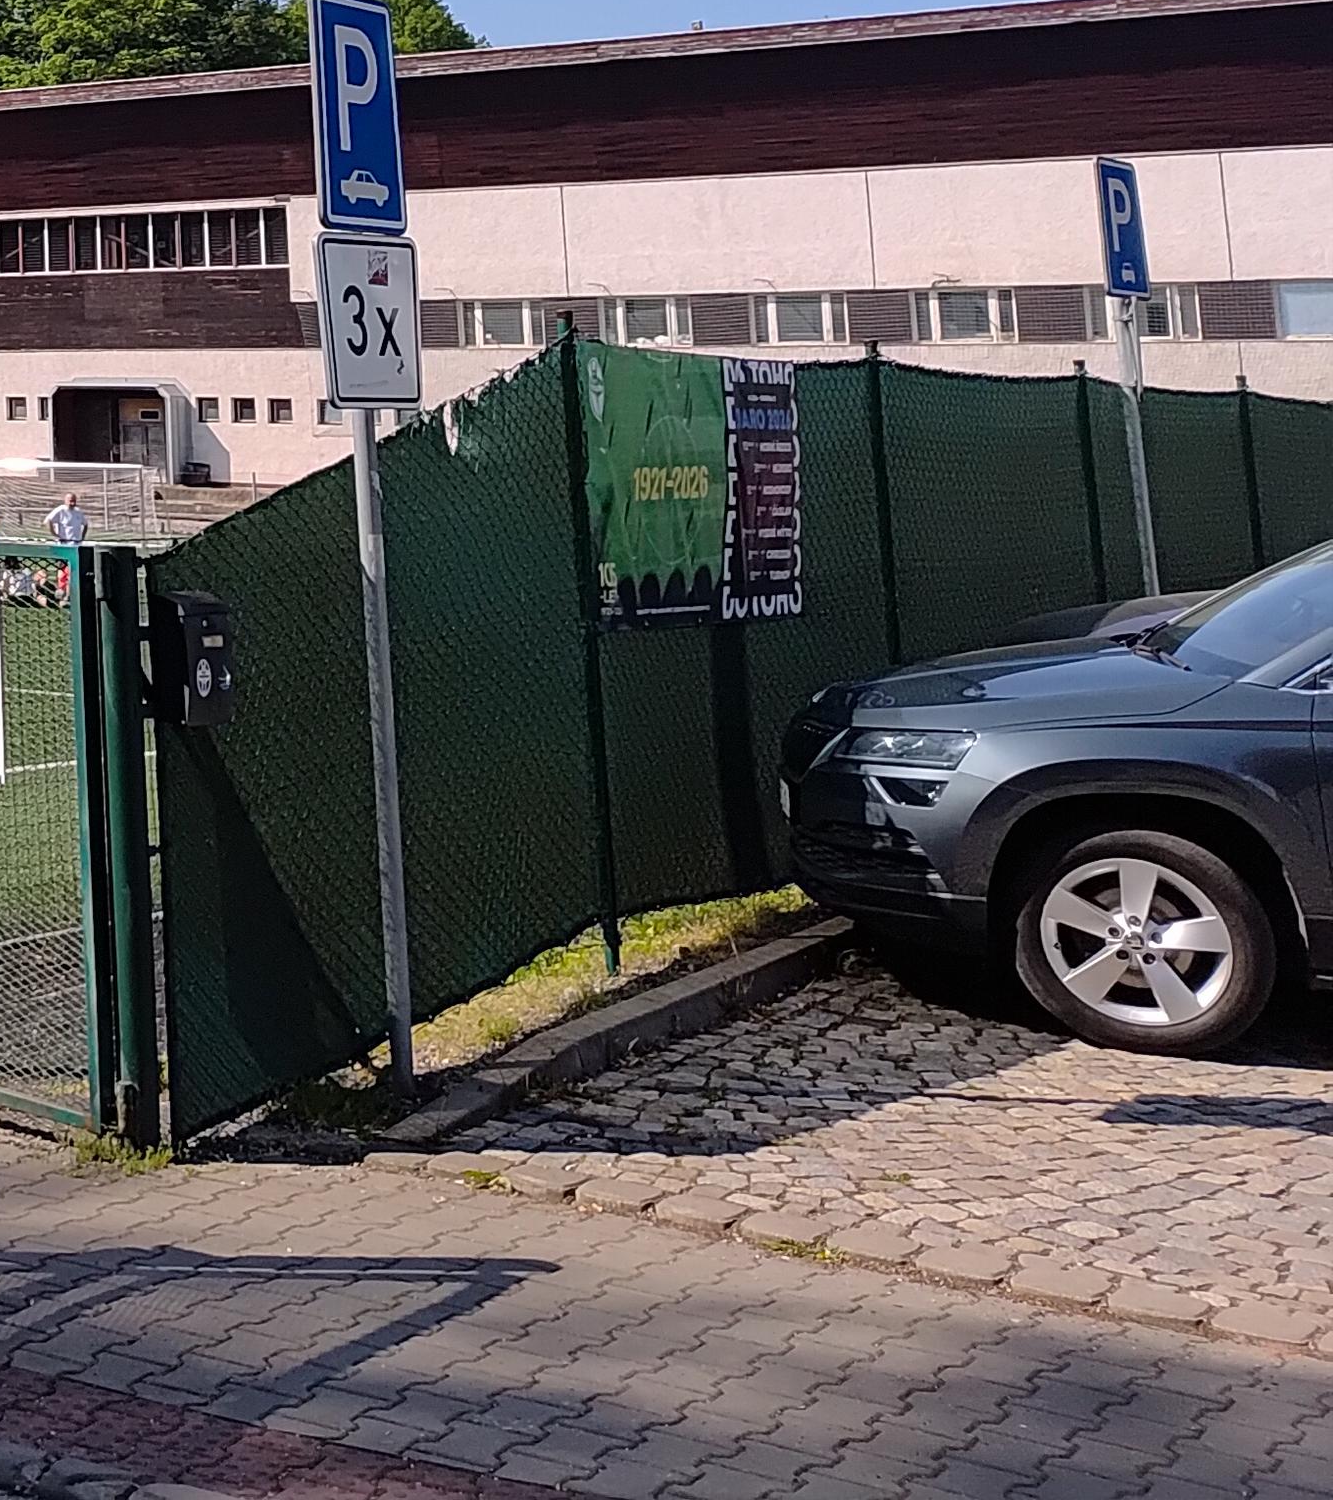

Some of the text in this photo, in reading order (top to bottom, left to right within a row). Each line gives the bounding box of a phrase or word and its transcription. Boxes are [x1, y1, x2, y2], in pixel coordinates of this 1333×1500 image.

[334, 24, 378, 151] P
[1107, 177, 1131, 252] P
[634, 465, 709, 501] 1921-2026
